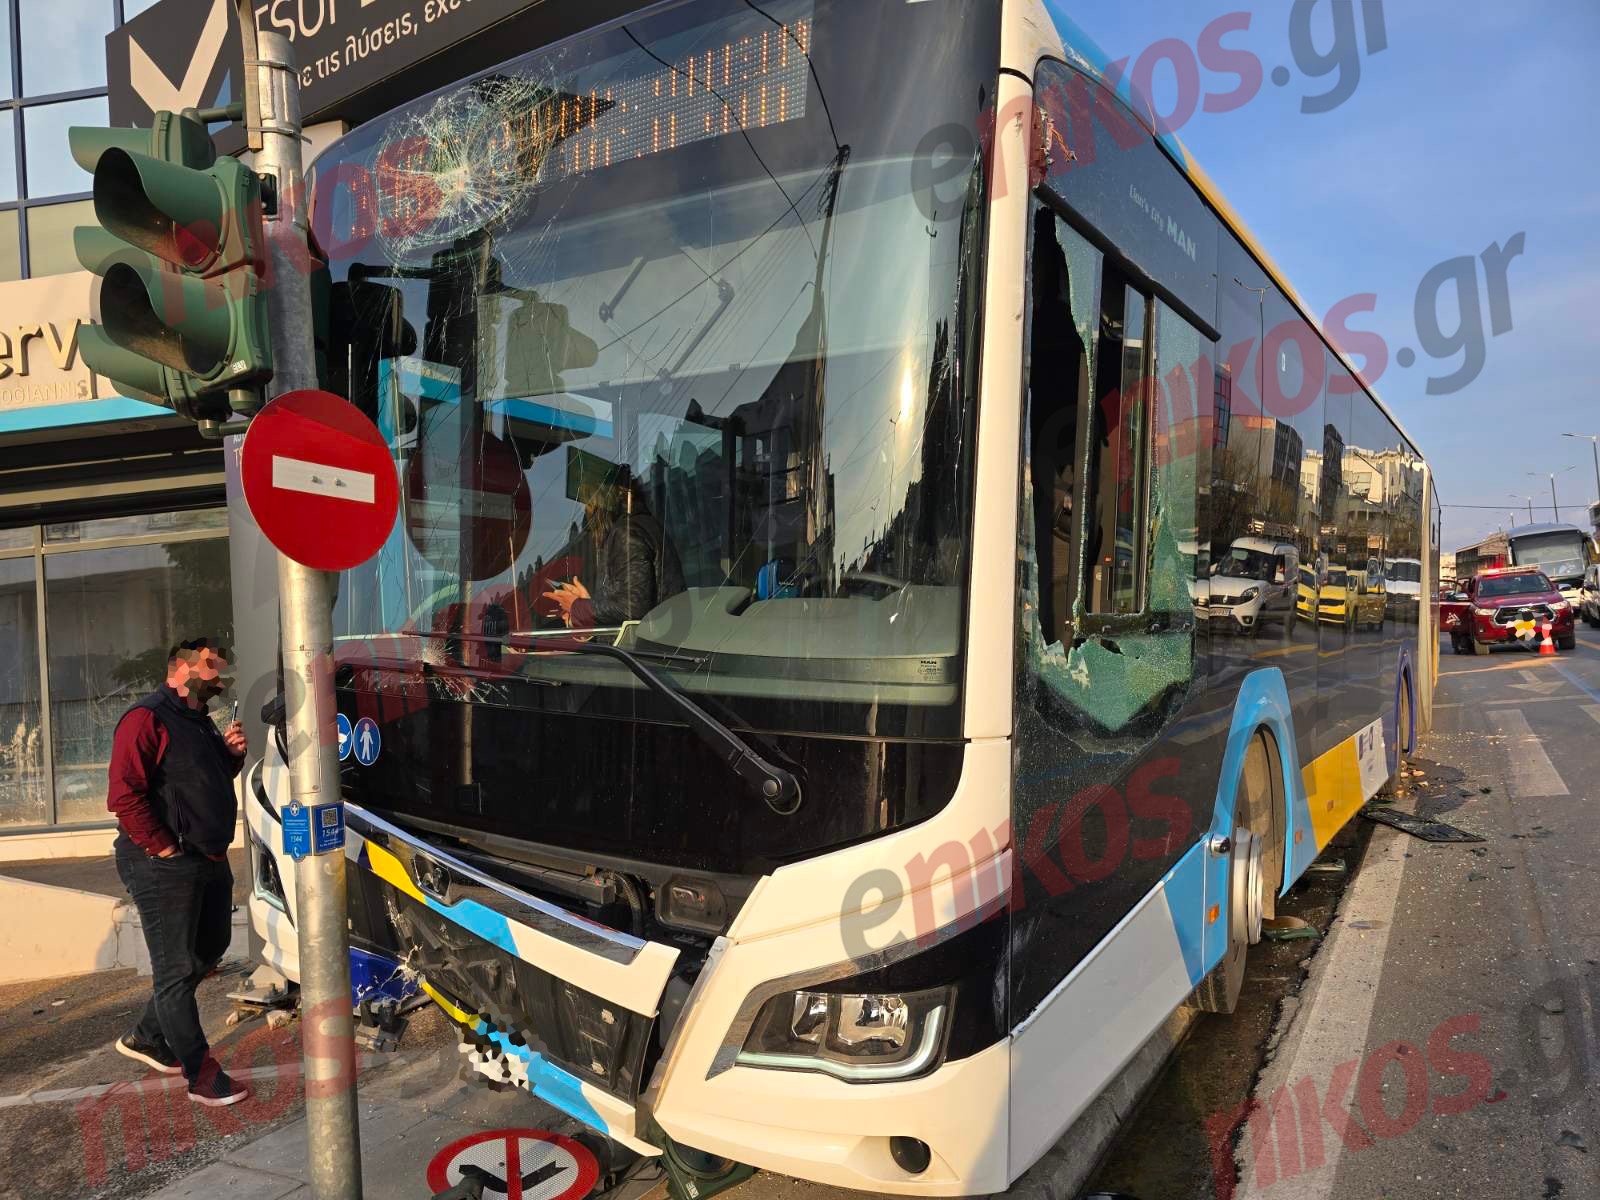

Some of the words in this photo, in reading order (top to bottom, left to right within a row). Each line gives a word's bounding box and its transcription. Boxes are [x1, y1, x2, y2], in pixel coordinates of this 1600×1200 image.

[315, 51, 340, 79] τις
[345, 12, 418, 66] λύσεις,
[1167, 215, 1196, 262] MAN
